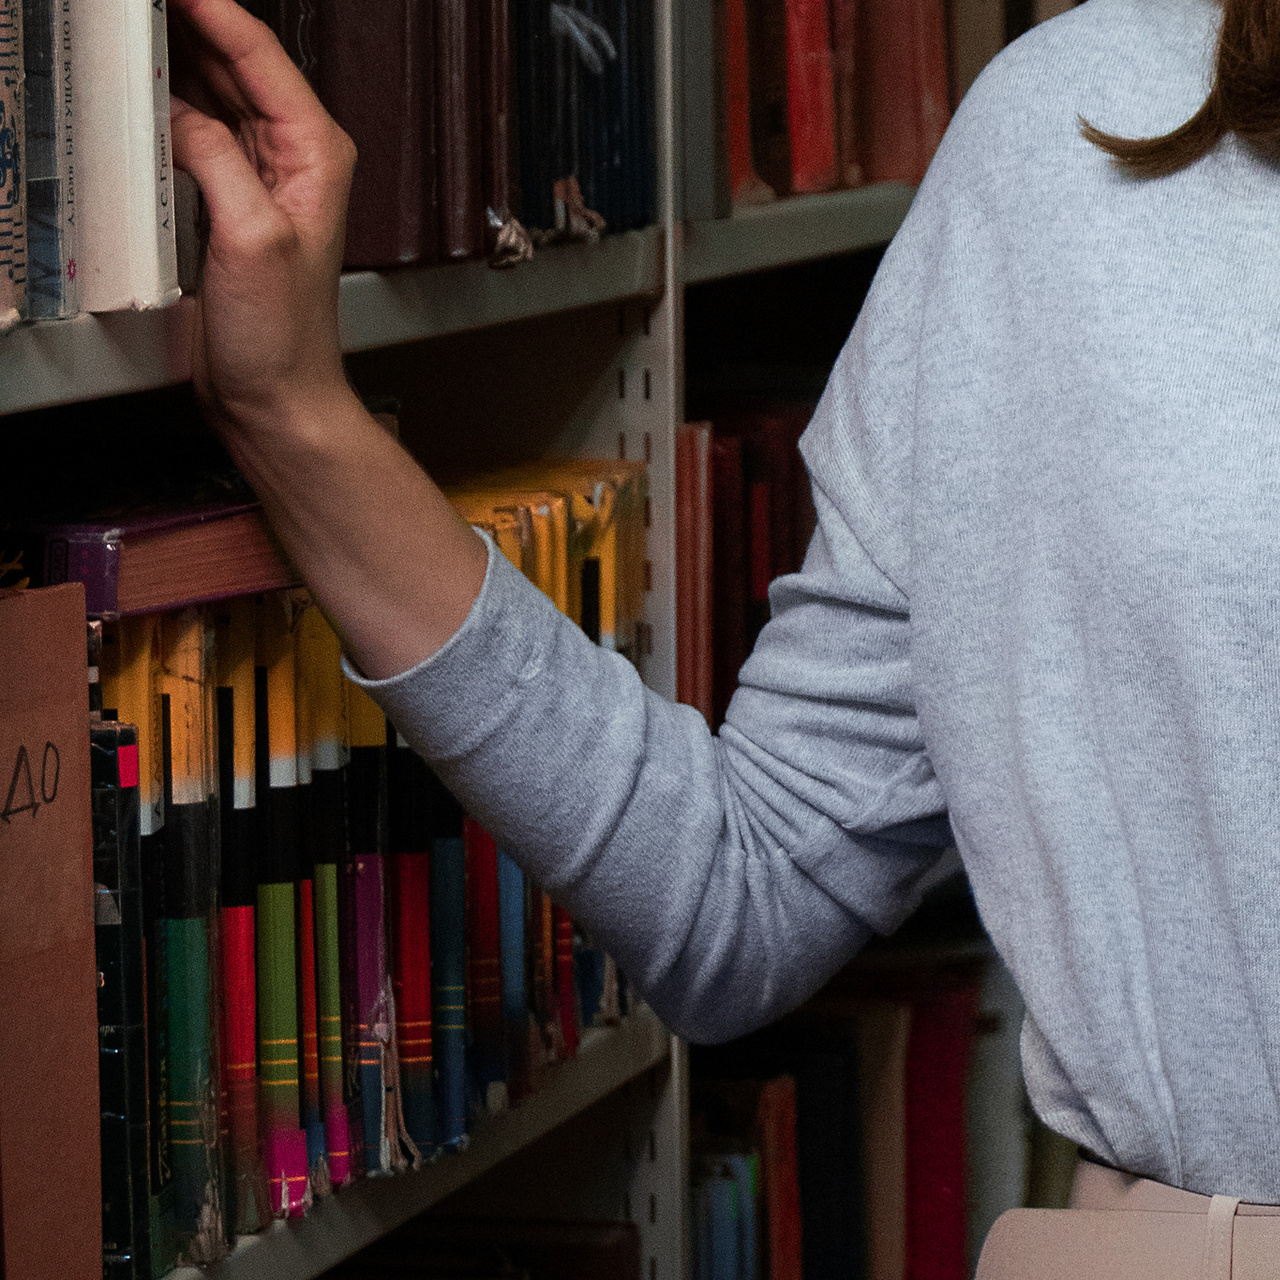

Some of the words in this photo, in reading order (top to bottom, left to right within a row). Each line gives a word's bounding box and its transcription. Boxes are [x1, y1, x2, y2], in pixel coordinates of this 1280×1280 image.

[62, 20, 71, 52] ПО
[63, 60, 74, 157] БЕГУЩАЯ
[157, 132, 169, 183] Грин
[159, 187, 169, 207] С.
[160, 211, 171, 230] А.
